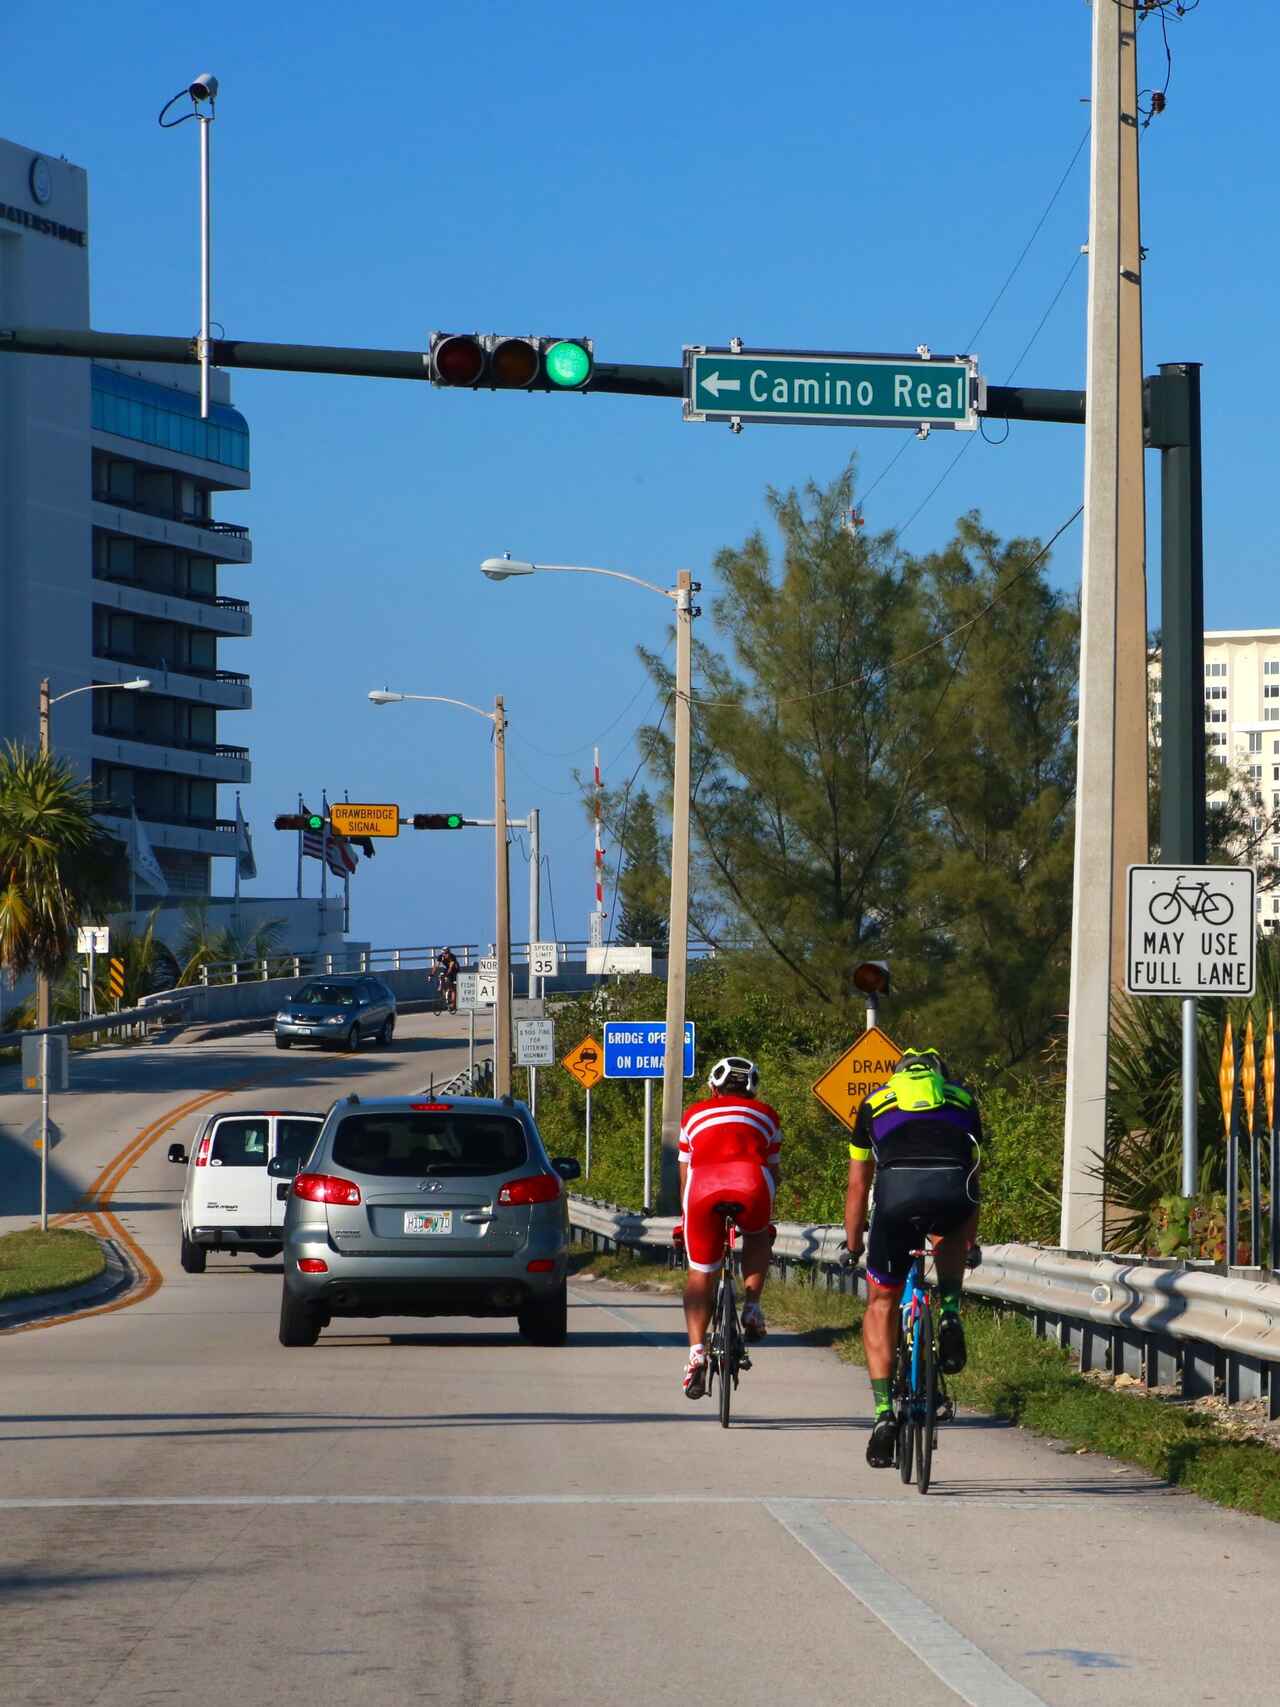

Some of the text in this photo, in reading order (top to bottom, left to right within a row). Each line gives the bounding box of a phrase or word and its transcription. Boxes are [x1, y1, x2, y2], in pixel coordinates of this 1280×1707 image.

[750, 369, 963, 409] Camino Real
[335, 808, 394, 820] DRAWBRIDGE
[348, 821, 381, 832] SIGNAL
[1144, 932, 1238, 955] MAY USE
[481, 961, 498, 970] NOR
[535, 960, 553, 973] 35
[1135, 962, 1246, 985] FULL LANE
[480, 986, 496, 997] A1
[608, 1032, 690, 1044] BRIDGE OPEG
[617, 1055, 666, 1069] ON DEMA
[853, 1060, 896, 1073] DRAW
[848, 1082, 881, 1096] BRID
